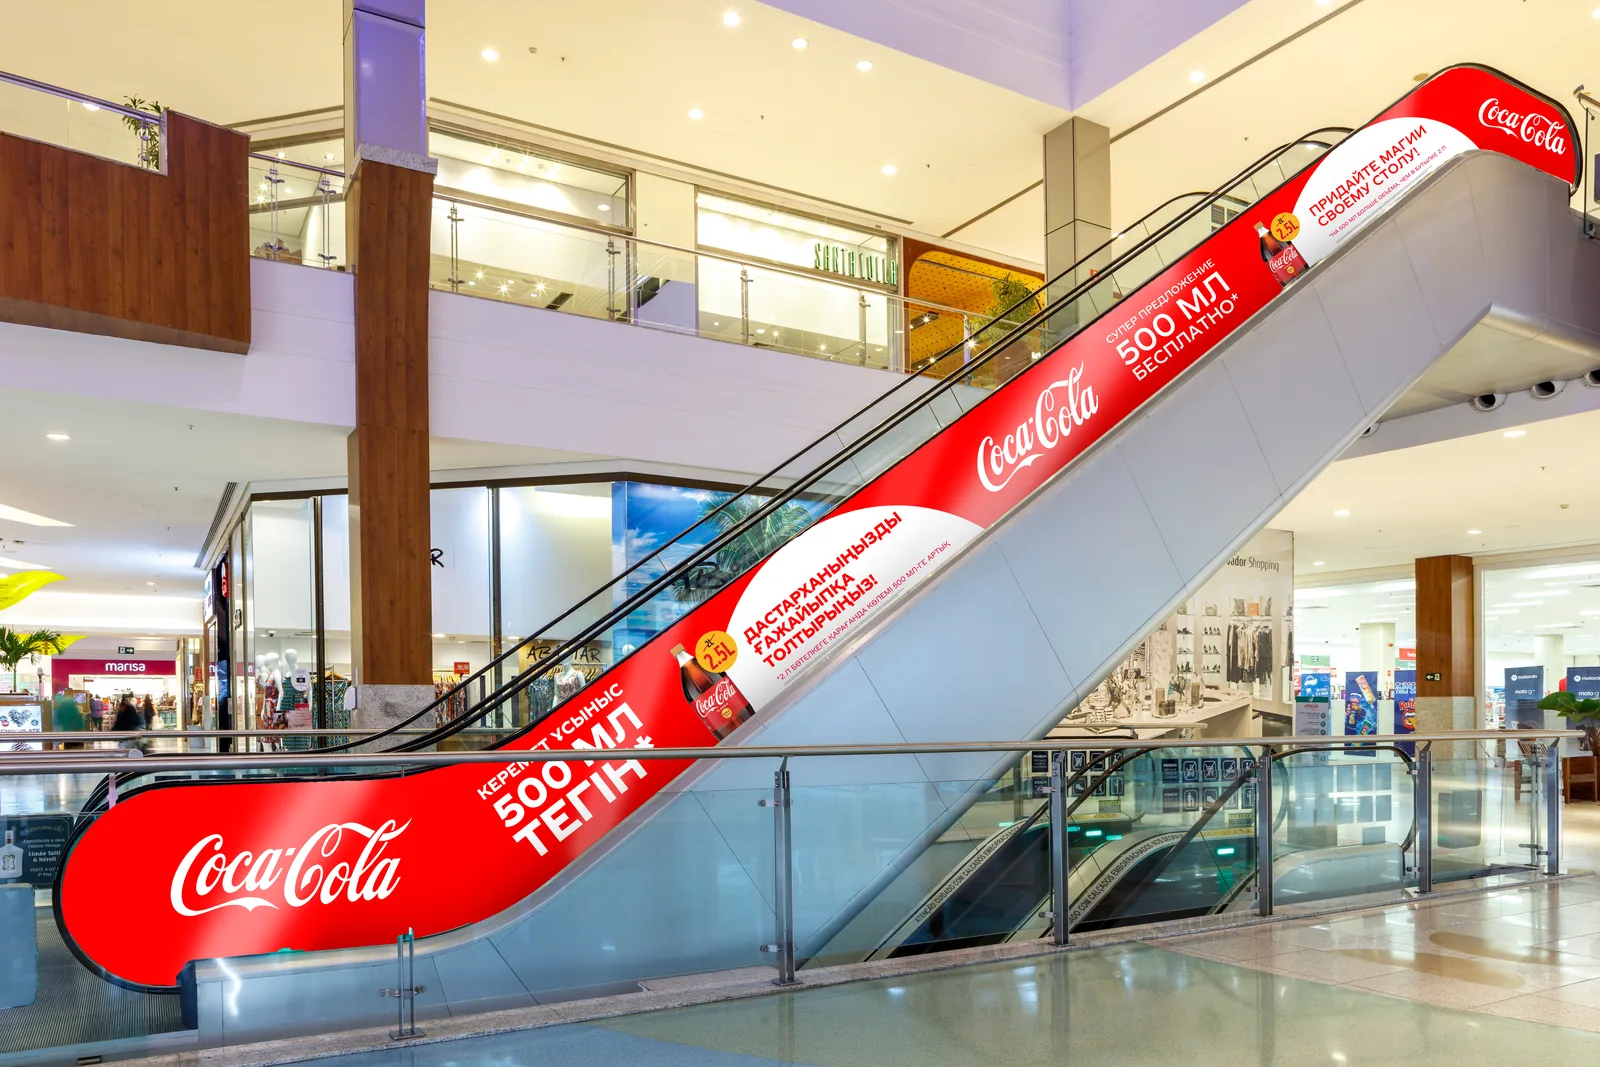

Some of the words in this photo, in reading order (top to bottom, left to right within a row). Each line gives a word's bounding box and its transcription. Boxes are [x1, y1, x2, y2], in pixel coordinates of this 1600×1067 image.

[1478, 98, 1566, 154] Coca-Cola
[1308, 160, 1380, 216] ПРИДАЙТЕ
[1379, 125, 1427, 164] МАГИИ
[1318, 182, 1370, 226] СВОЕМУ
[1372, 147, 1420, 186] СТОЛУ!
[1338, 221, 1349, 231] 500
[1356, 198, 1379, 216] БОЛЬШЕ
[1400, 172, 1411, 184] ЧЕМ
[1415, 151, 1438, 172] БУТЫЛКЕ
[814, 243, 856, 277] SANTA
[859, 252, 897, 286] LOLLA
[1269, 246, 1298, 273] Coca-Cola
[1276, 220, 1299, 240] 2.5L
[1106, 316, 1138, 344] СУПЕР
[1138, 258, 1215, 320] ПРЕДЛОЖЕНИЕ
[1115, 313, 1175, 366] 500
[1176, 271, 1230, 320] МЛ
[977, 360, 1099, 492] Coca-Cola
[743, 511, 902, 645] ДАСТАРХАНЫҢЫЗДЫ
[1227, 556, 1247, 566] vador
[1248, 557, 1279, 573] Shopping
[753, 572, 856, 655] ҒАЖАЙЫПҚА
[763, 574, 879, 668] ТОЛТЫРЫҢЫЗ!
[791, 639, 829, 671] БӨТЕЛКЕГЕ
[892, 576, 907, 589] 500
[906, 559, 927, 579] МЛ-ГЕ
[105, 661, 146, 672] marisa
[704, 641, 735, 670] 2.5L
[695, 678, 736, 718] Coca-Cola
[477, 738, 550, 800] КЕРЕМТ
[492, 760, 572, 828] 500
[571, 702, 644, 767] МЛ
[170, 817, 412, 916] Coca-Cola
[935, 885, 956, 904] CUIDADO
[952, 874, 965, 887] COM
[962, 854, 986, 877] CALÇADOS
[1078, 897, 1092, 911] COM
[1088, 874, 1114, 899] CALÇADOS
[1111, 843, 1154, 876] EMBORRACHADOS
